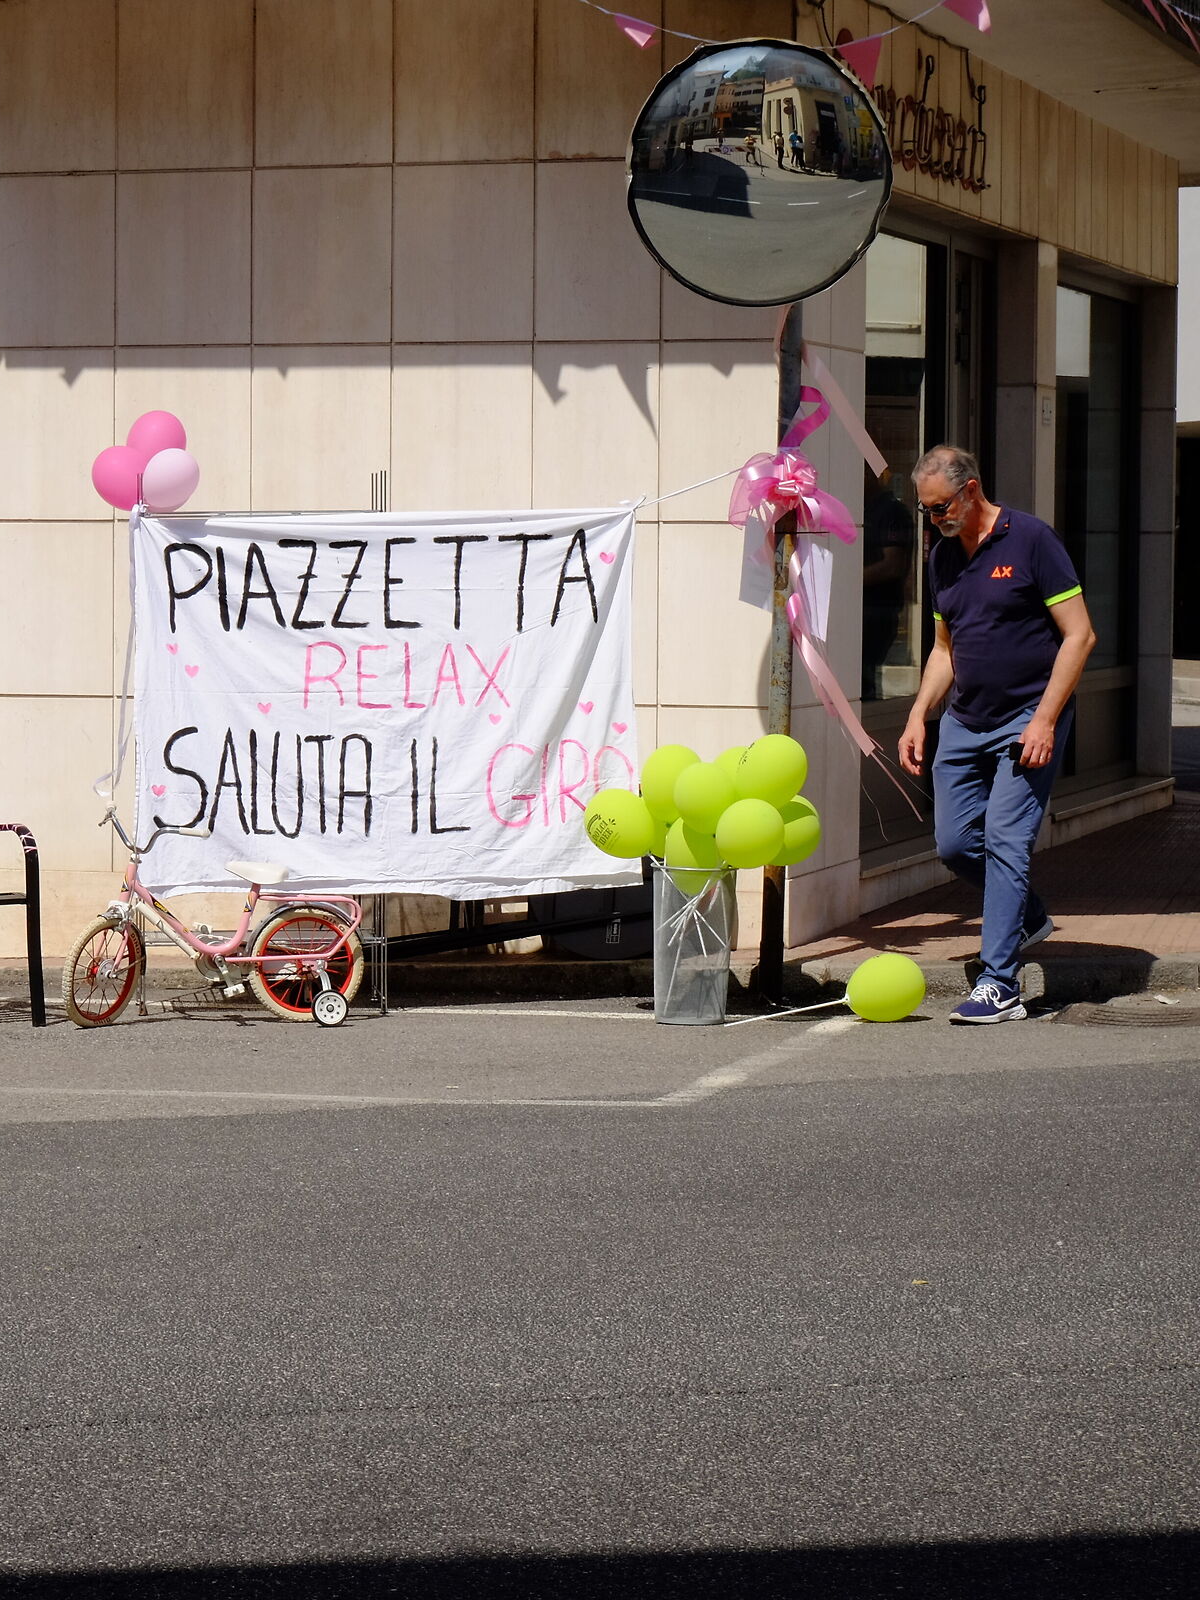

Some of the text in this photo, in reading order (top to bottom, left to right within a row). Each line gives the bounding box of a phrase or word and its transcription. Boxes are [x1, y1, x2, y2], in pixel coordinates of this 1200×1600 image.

[163, 528, 598, 634] PIAZZETTA
[301, 641, 511, 710] RELAX
[153, 726, 373, 840] SALUTA
[410, 736, 471, 835] IL
